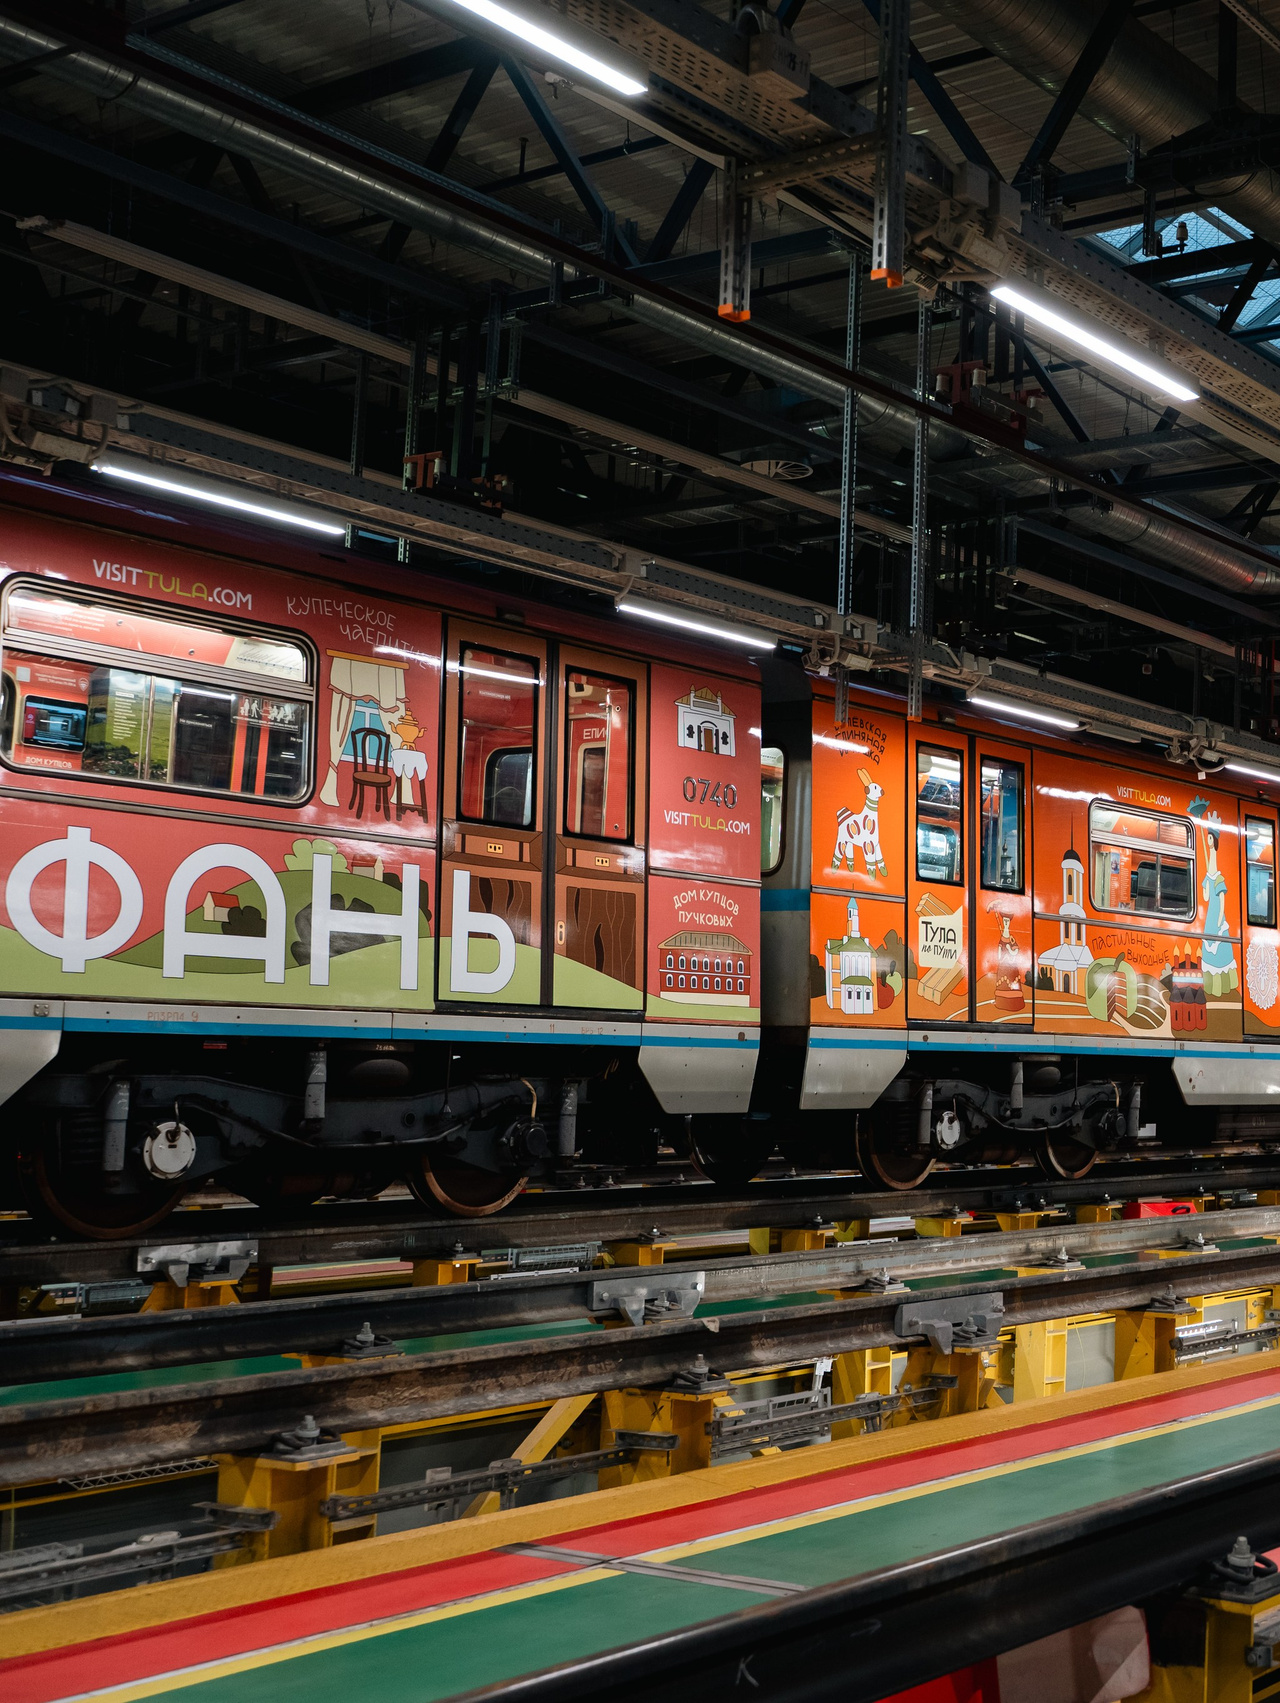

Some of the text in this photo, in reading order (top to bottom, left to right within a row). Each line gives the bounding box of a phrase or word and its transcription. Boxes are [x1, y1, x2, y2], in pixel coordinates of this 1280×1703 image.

[92, 558, 253, 611] VISITTULA.COM
[286, 596, 397, 632] КУПЕЧЕСКОЕ
[682, 776, 738, 810] 0740
[1116, 785, 1171, 808] VISITTULA.COM
[663, 808, 751, 835] VISITTULA.COM
[4, 825, 517, 996] ФАНЬ
[673, 889, 740, 917] ДОМ КУПЦОВ
[677, 910, 734, 928] ПУЧКОВЫХ
[920, 921, 957, 945] ТУЛА
[1091, 931, 1156, 952] ПАСТИЛЬНЫЕ
[1126, 948, 1170, 967] ВЫХОДНЫЕ
